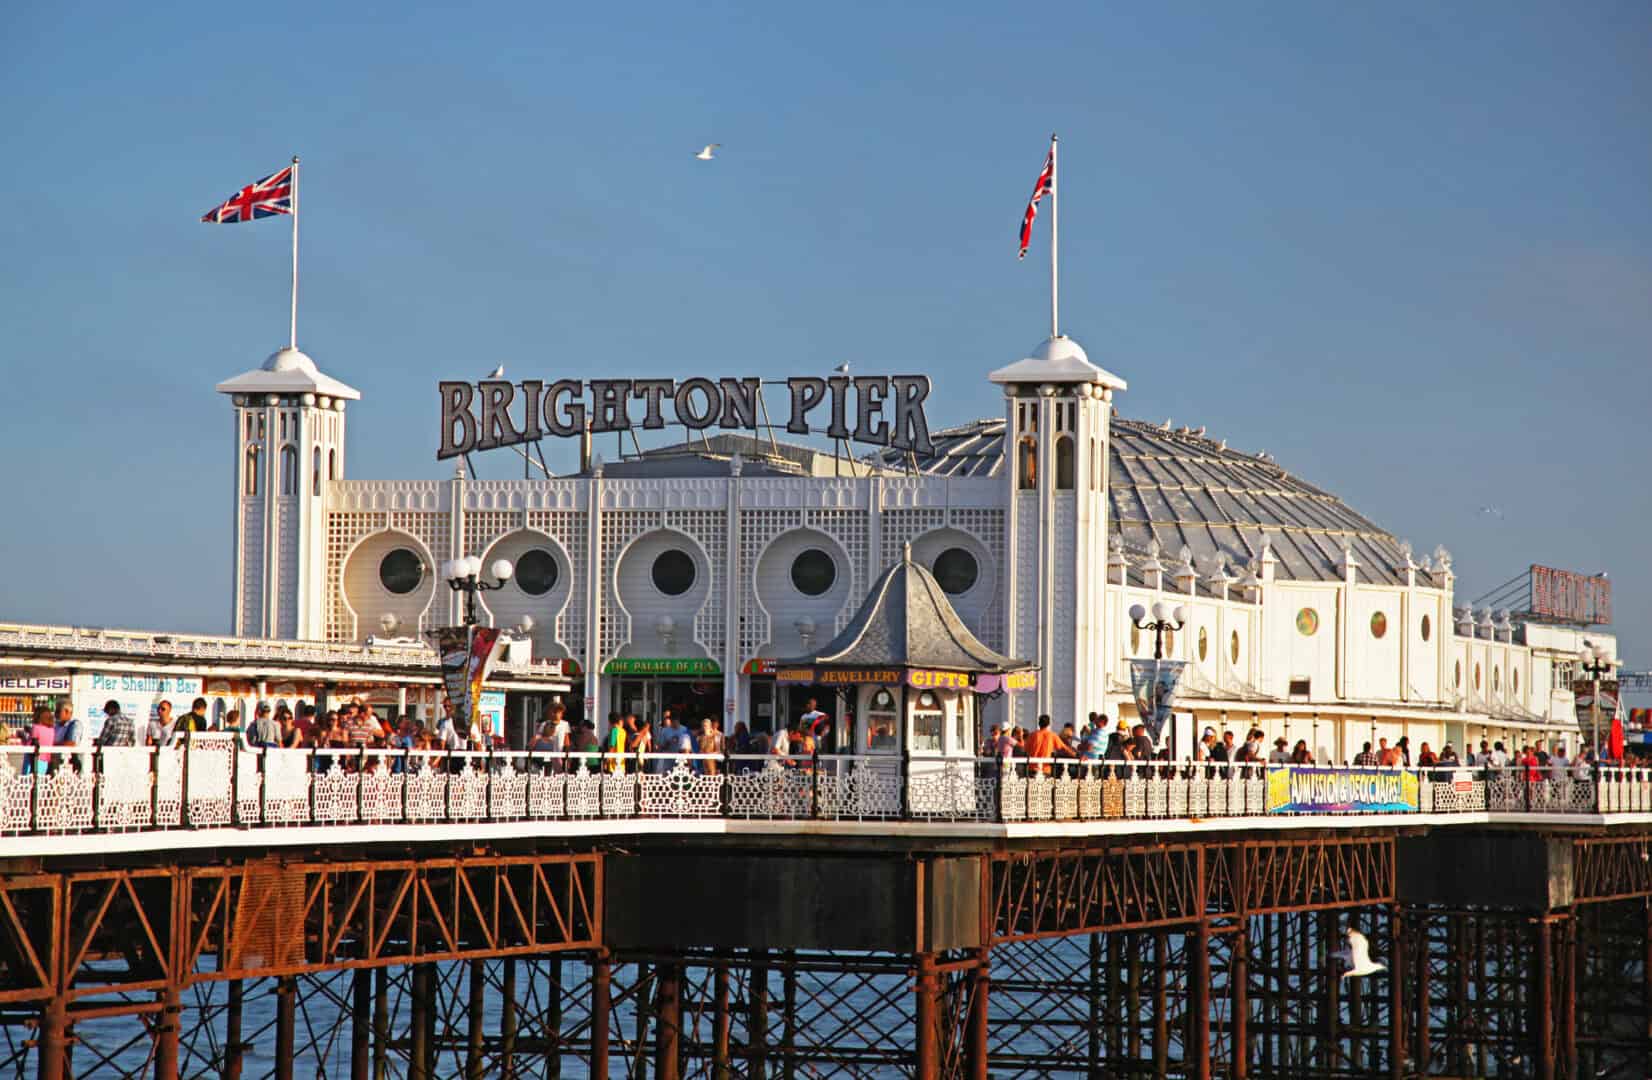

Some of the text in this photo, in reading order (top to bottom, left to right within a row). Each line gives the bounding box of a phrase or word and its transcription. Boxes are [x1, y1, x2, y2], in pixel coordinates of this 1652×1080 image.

[438, 375, 936, 459] BRIGHTON PIER
[676, 662, 690, 672] OF
[92, 672, 197, 693] Pier Shellfish Bar
[822, 671, 901, 683] JEWELLERY
[911, 671, 969, 687] GIFTS
